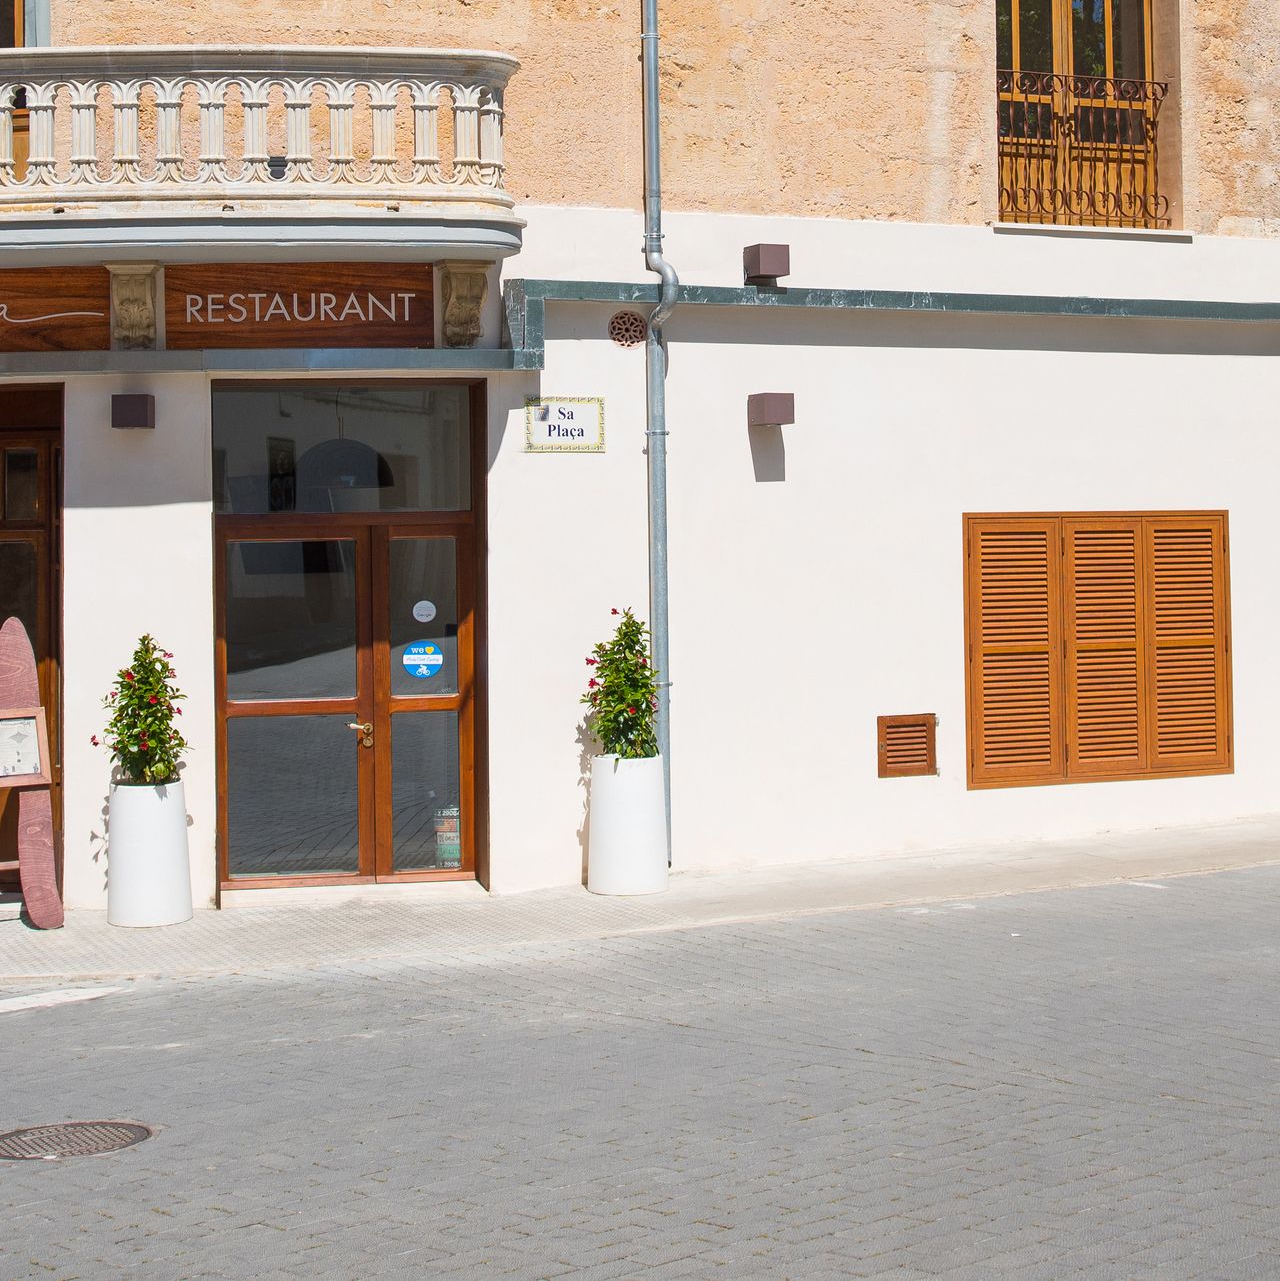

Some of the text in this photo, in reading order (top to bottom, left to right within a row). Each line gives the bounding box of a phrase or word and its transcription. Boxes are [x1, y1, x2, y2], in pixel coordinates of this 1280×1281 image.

[186, 292, 416, 323] RESTAURANT
[558, 407, 574, 420] Sa
[547, 424, 584, 440] Plaça
